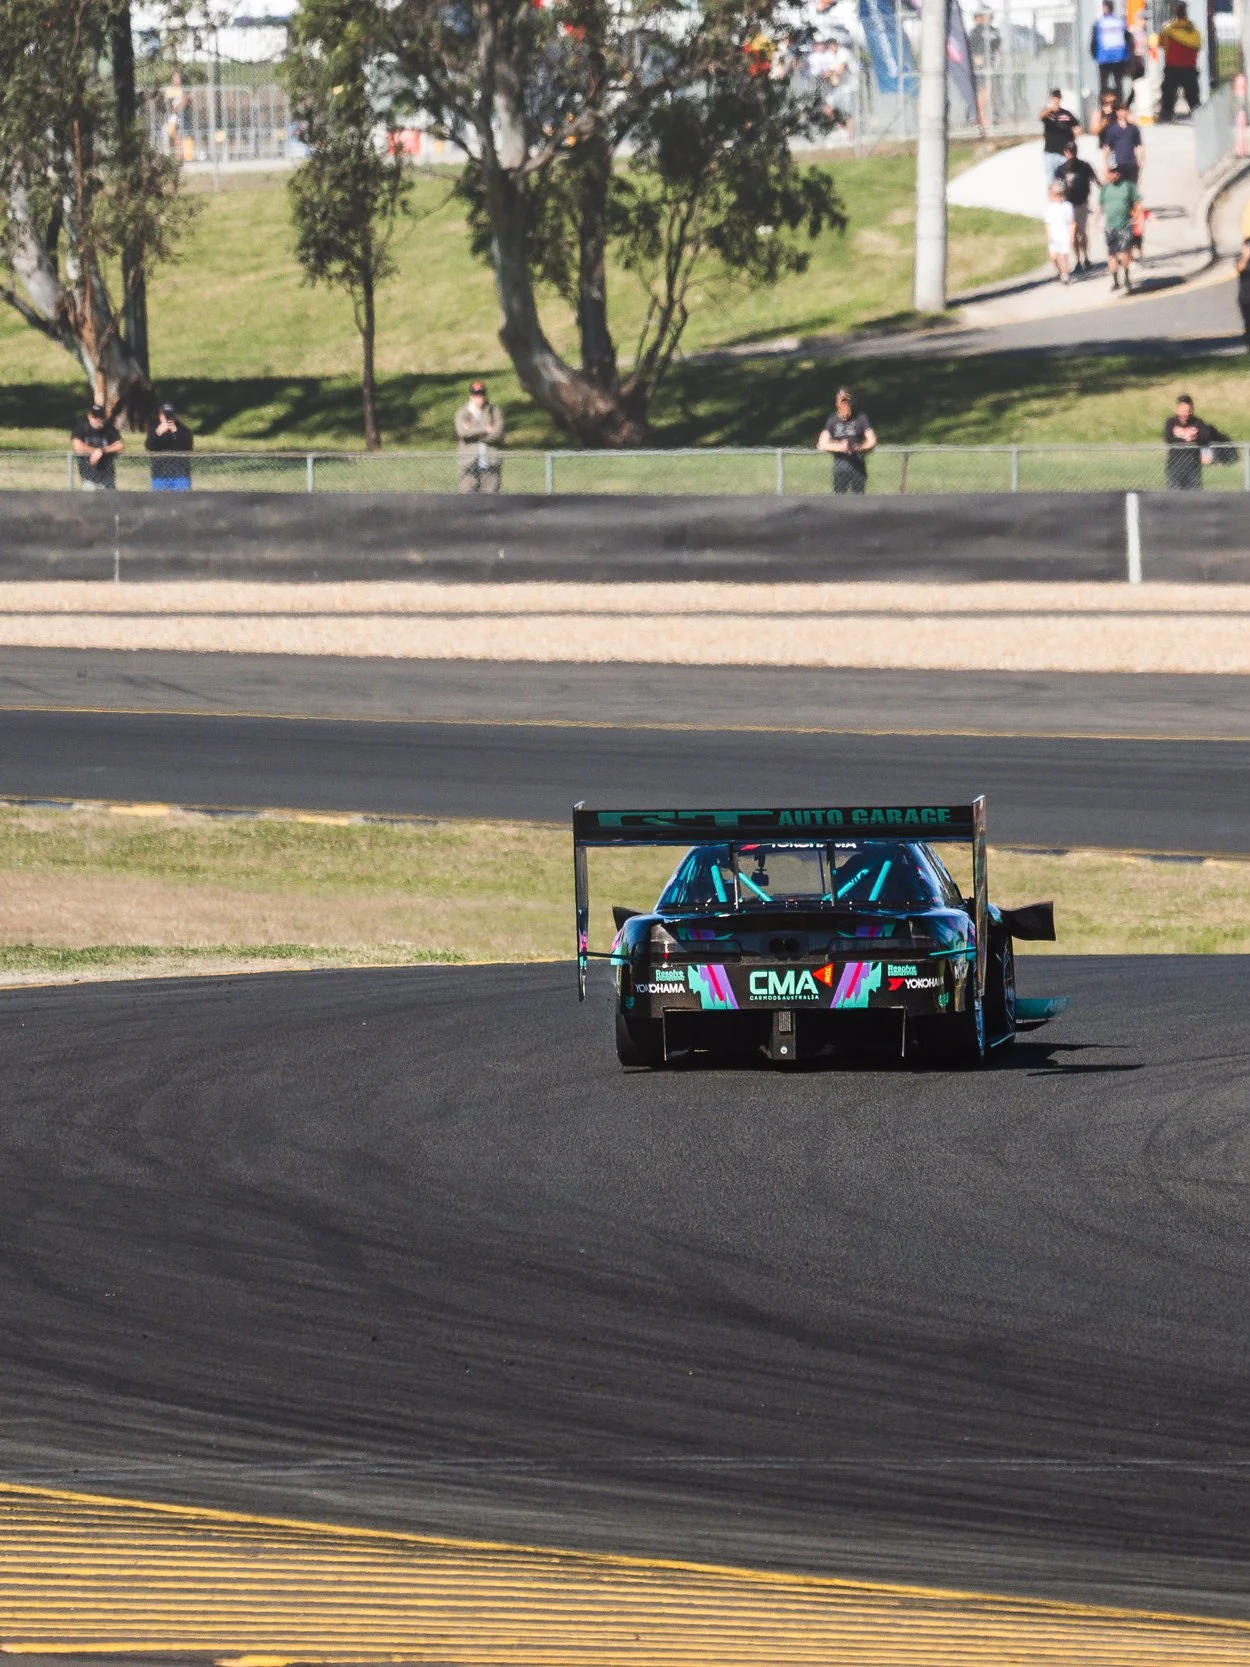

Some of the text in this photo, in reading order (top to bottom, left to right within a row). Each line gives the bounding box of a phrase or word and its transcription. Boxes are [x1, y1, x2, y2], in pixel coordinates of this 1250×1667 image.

[779, 810, 844, 826] AUTO
[852, 808, 951, 825] GARAGE
[749, 970, 819, 995] CMA
[824, 966, 832, 983] TOW
